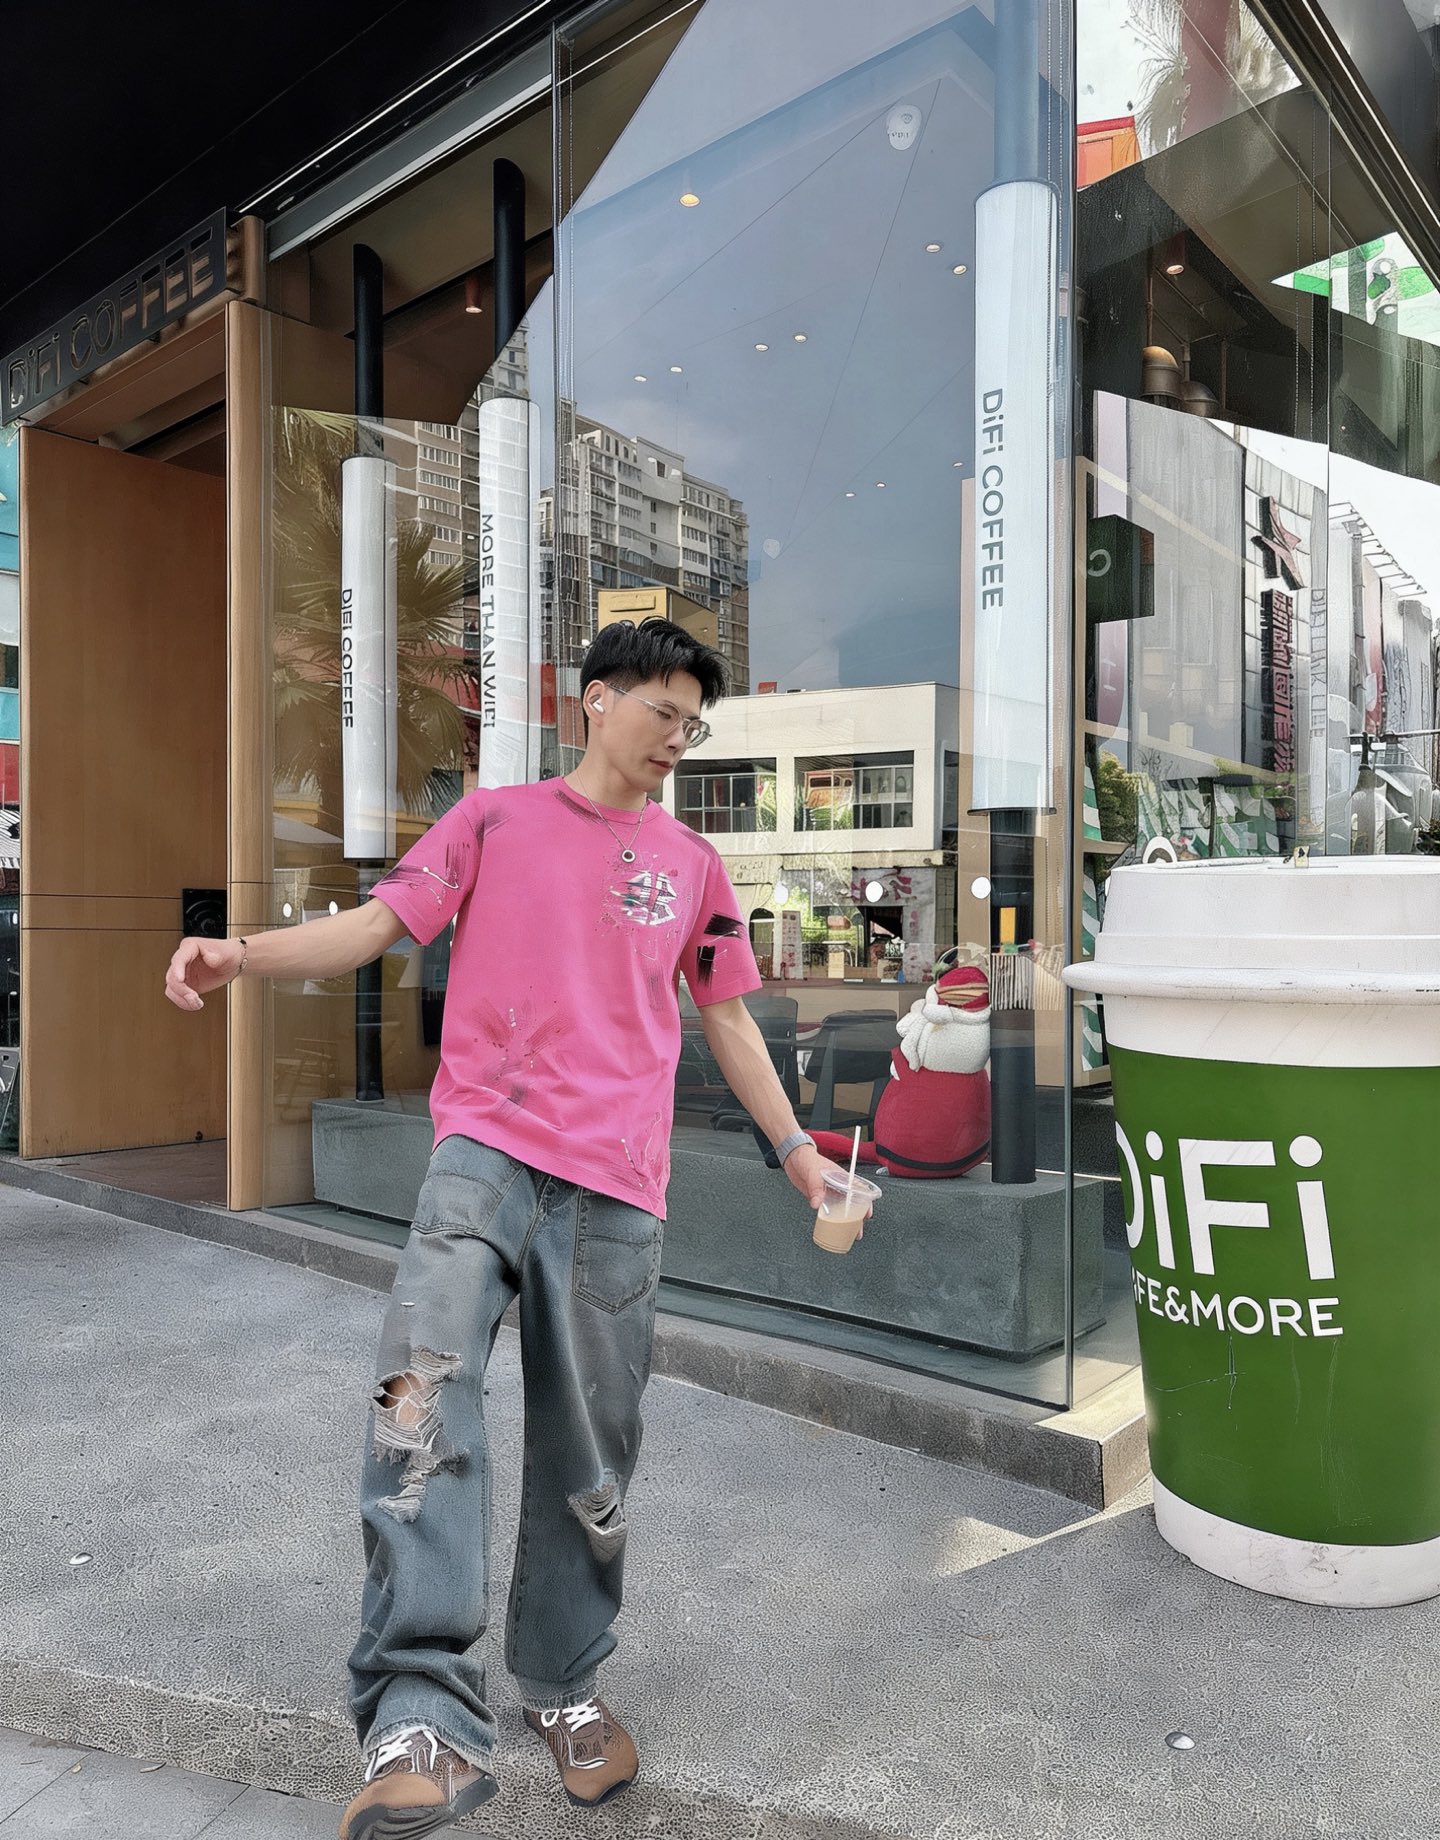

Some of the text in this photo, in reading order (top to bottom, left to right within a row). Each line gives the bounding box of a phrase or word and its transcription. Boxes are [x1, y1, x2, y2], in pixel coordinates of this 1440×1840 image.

[70, 226, 214, 371] COFFEE
[982, 388, 1004, 610] DiFi COFFEE
[481, 514, 494, 589] MORE
[482, 595, 496, 668] THAN
[1131, 1265, 1344, 1338] FE&MORE
